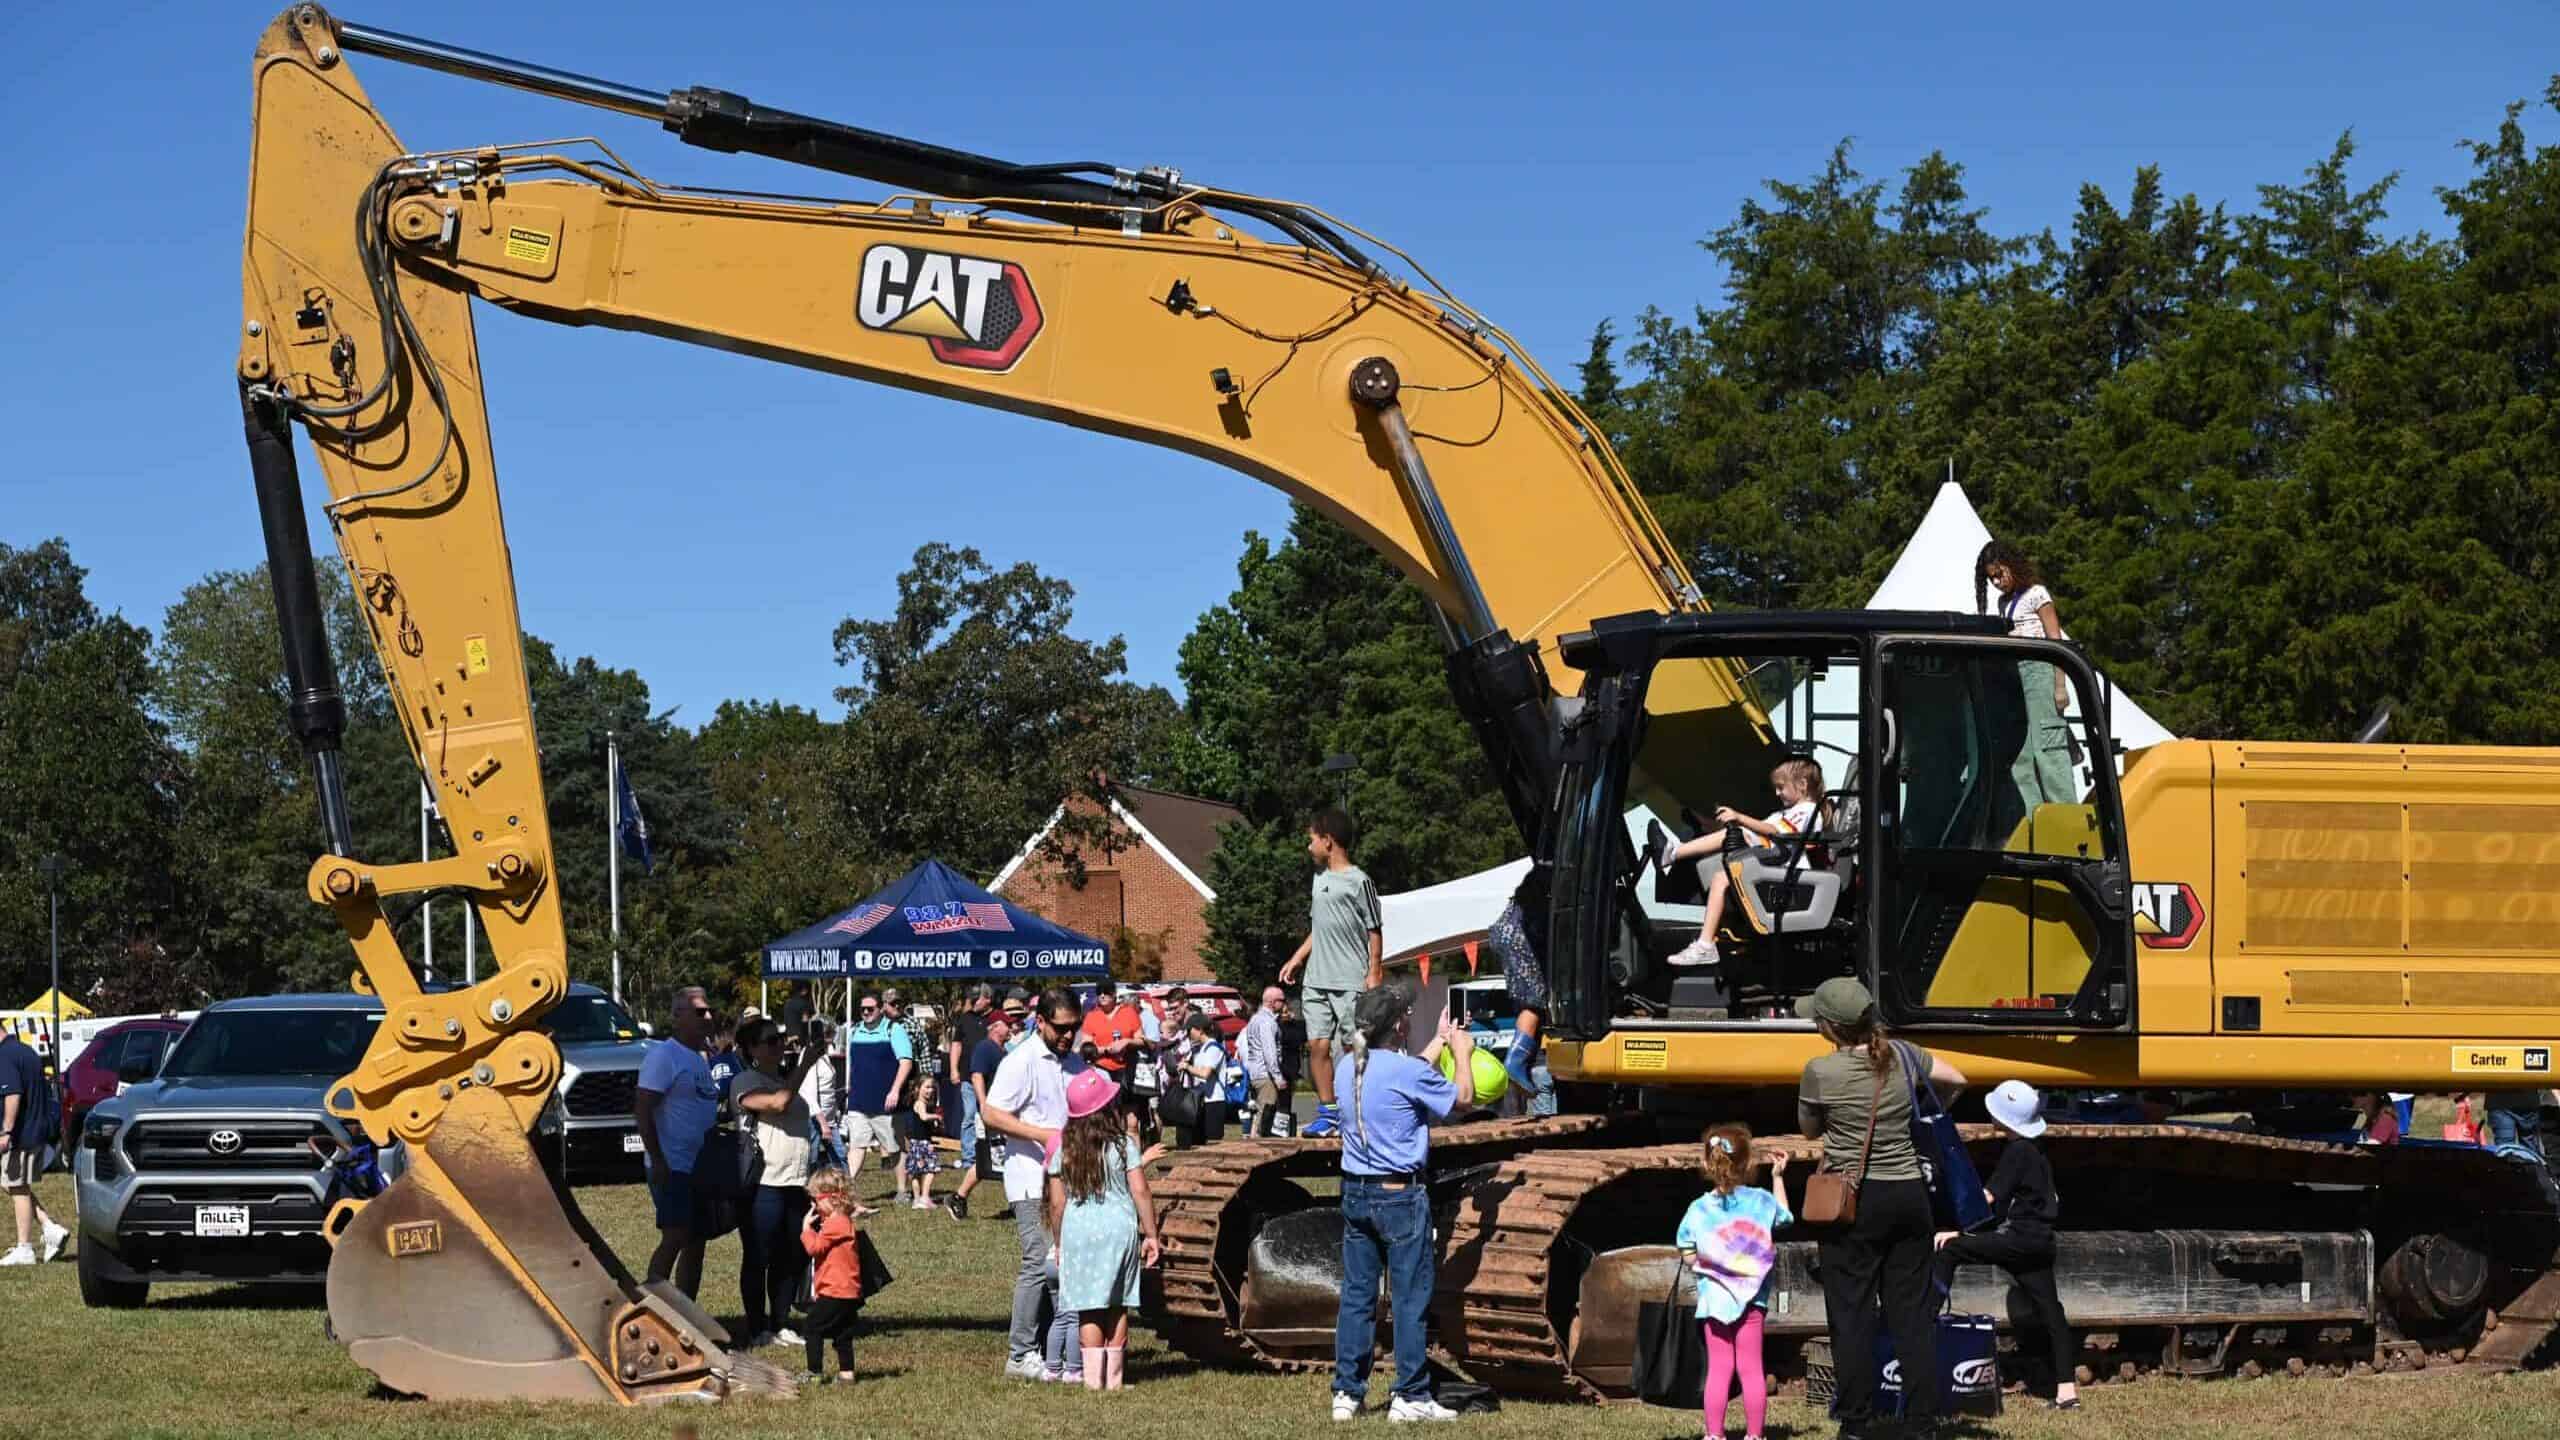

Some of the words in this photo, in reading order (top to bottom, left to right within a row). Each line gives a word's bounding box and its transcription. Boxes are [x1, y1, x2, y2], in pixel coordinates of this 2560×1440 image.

[859, 245, 1003, 343] CAT
[2132, 885, 2178, 933] AT
[770, 950, 841, 972] WWW.WMZQ.COM
[877, 951, 971, 970] @WMZQFM
[1036, 948, 1104, 967] @WMZQ
[2471, 1053, 2507, 1066] Carter
[2525, 1053, 2546, 1066] CAT
[400, 1227, 433, 1250] CAT
